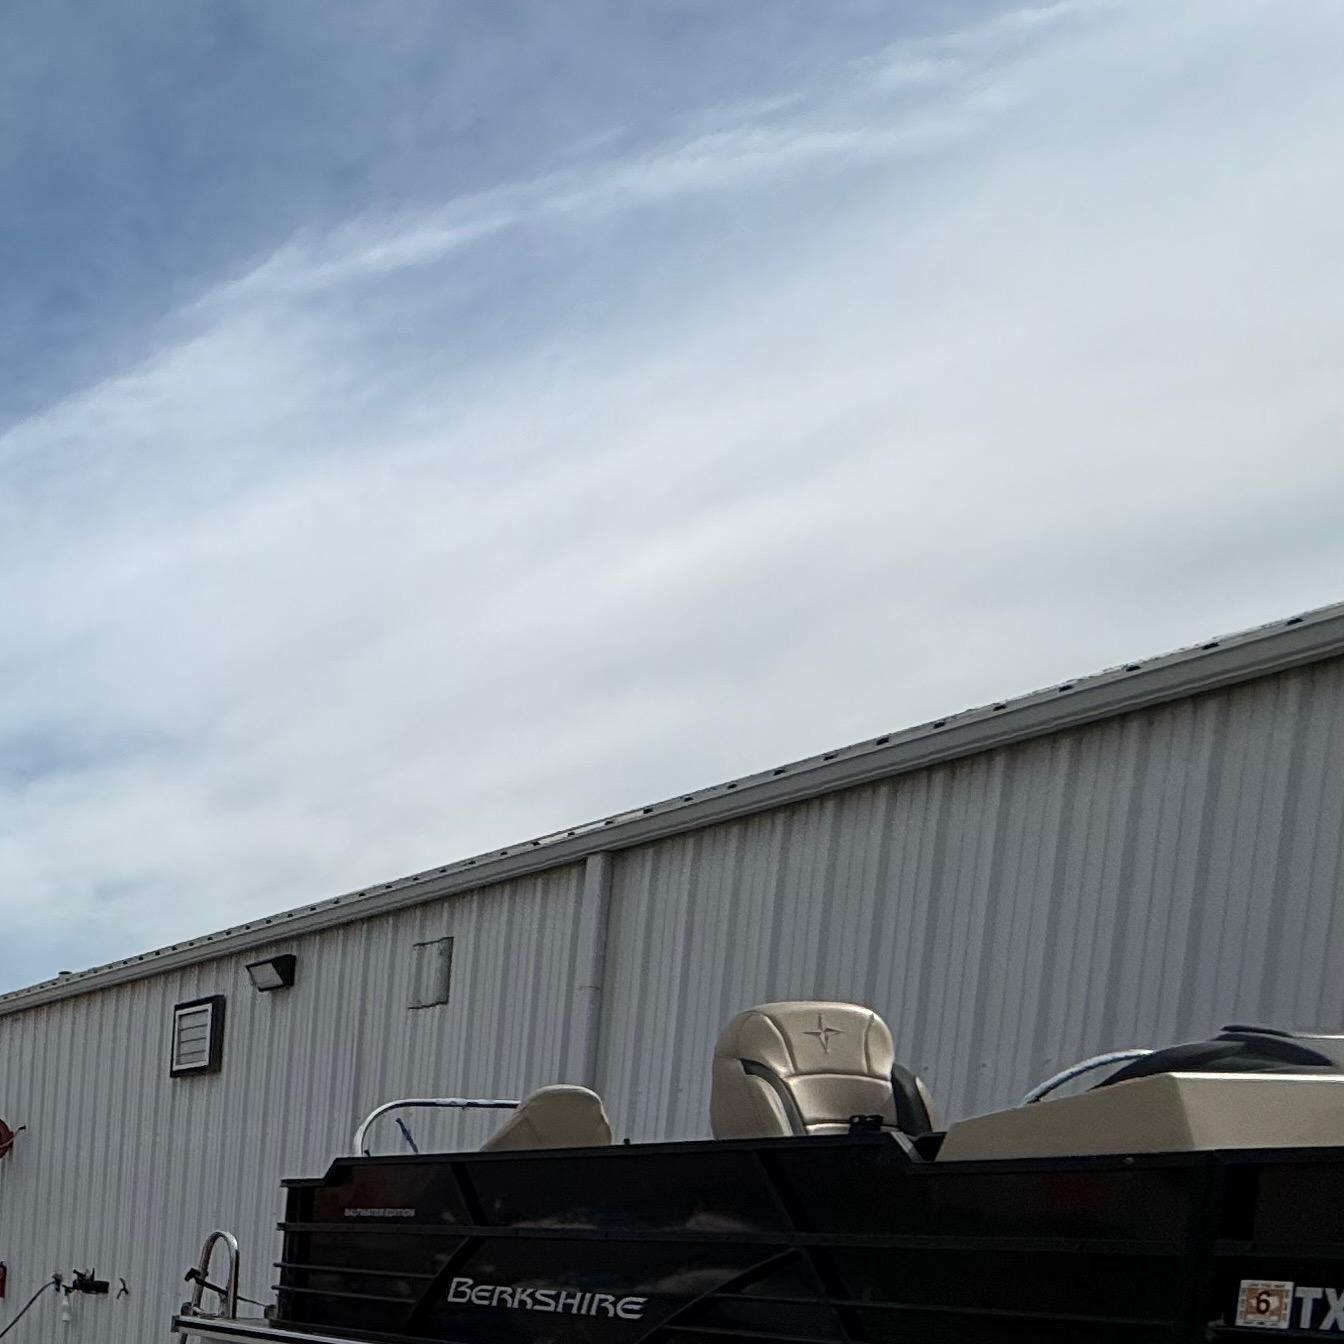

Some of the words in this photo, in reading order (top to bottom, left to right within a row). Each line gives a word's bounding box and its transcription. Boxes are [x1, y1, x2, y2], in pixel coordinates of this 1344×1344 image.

[447, 1277, 648, 1320] BERKSHIRE
[1256, 1291, 1271, 1314] 6
[1295, 1287, 1344, 1331] TX
